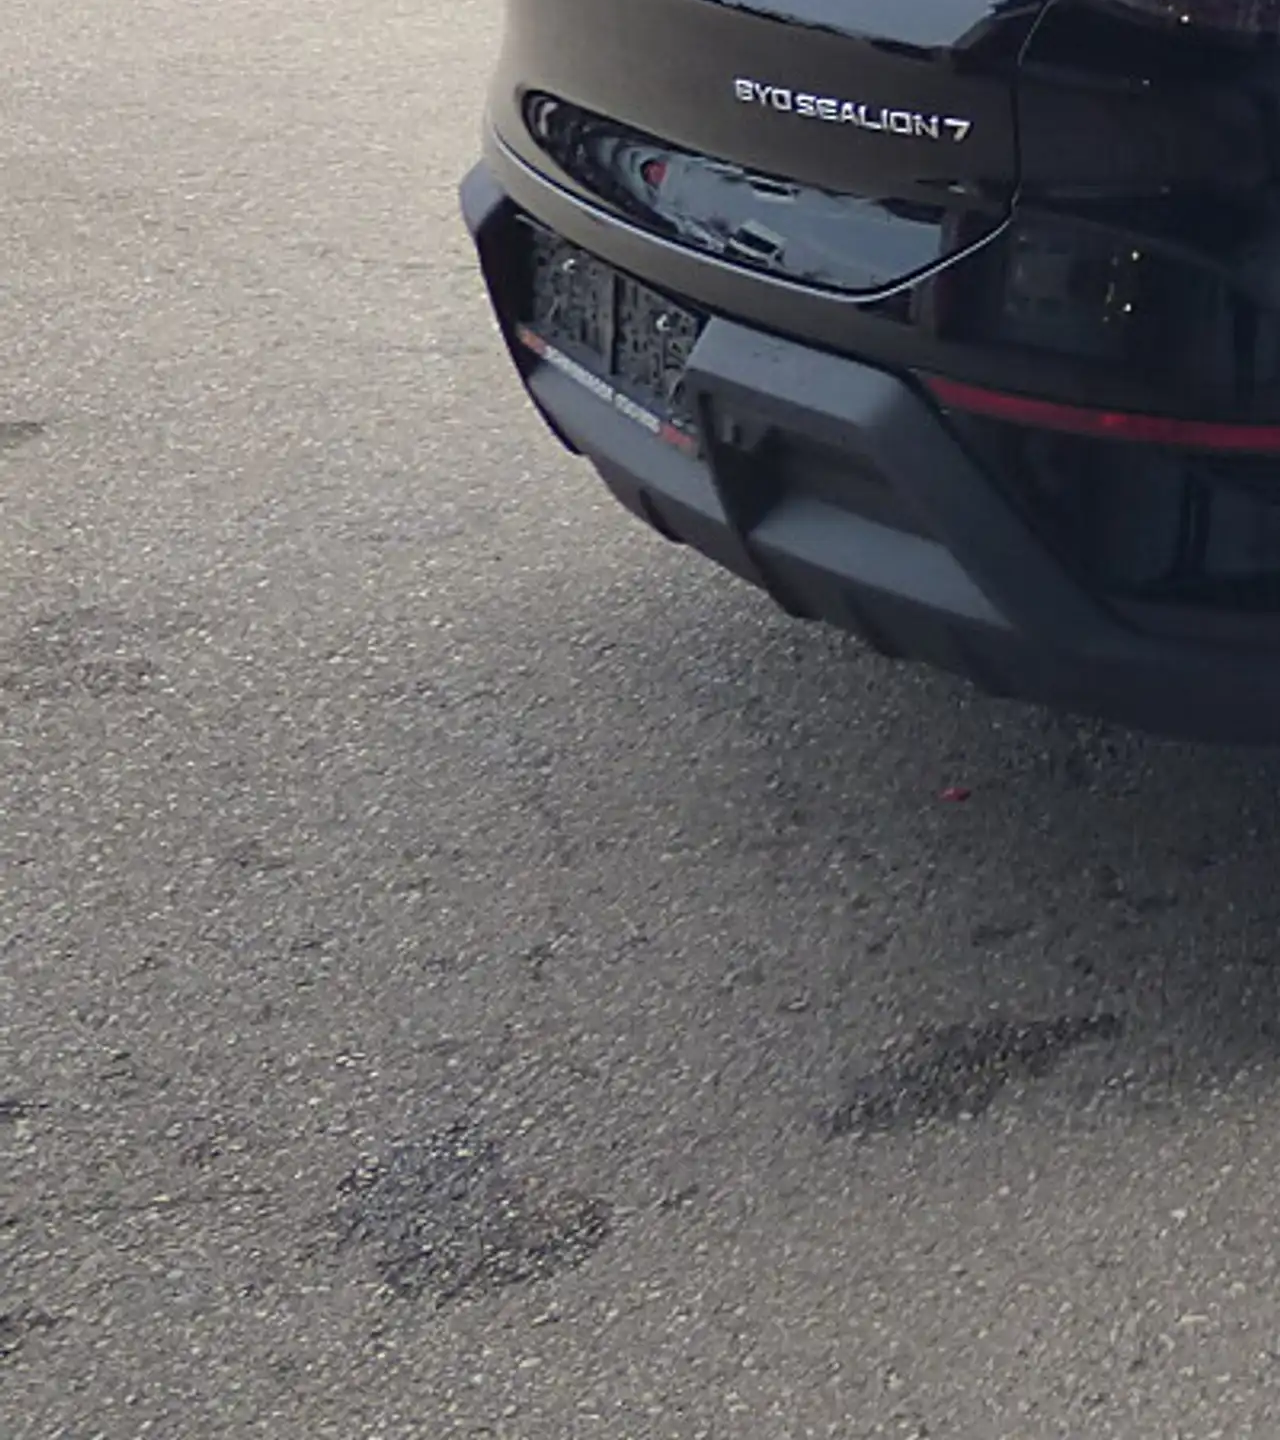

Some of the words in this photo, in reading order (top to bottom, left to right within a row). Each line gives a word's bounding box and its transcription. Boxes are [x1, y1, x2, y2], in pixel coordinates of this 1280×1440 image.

[734, 78, 791, 112] BYD
[794, 93, 939, 140] SEALION
[943, 117, 971, 143] 7
